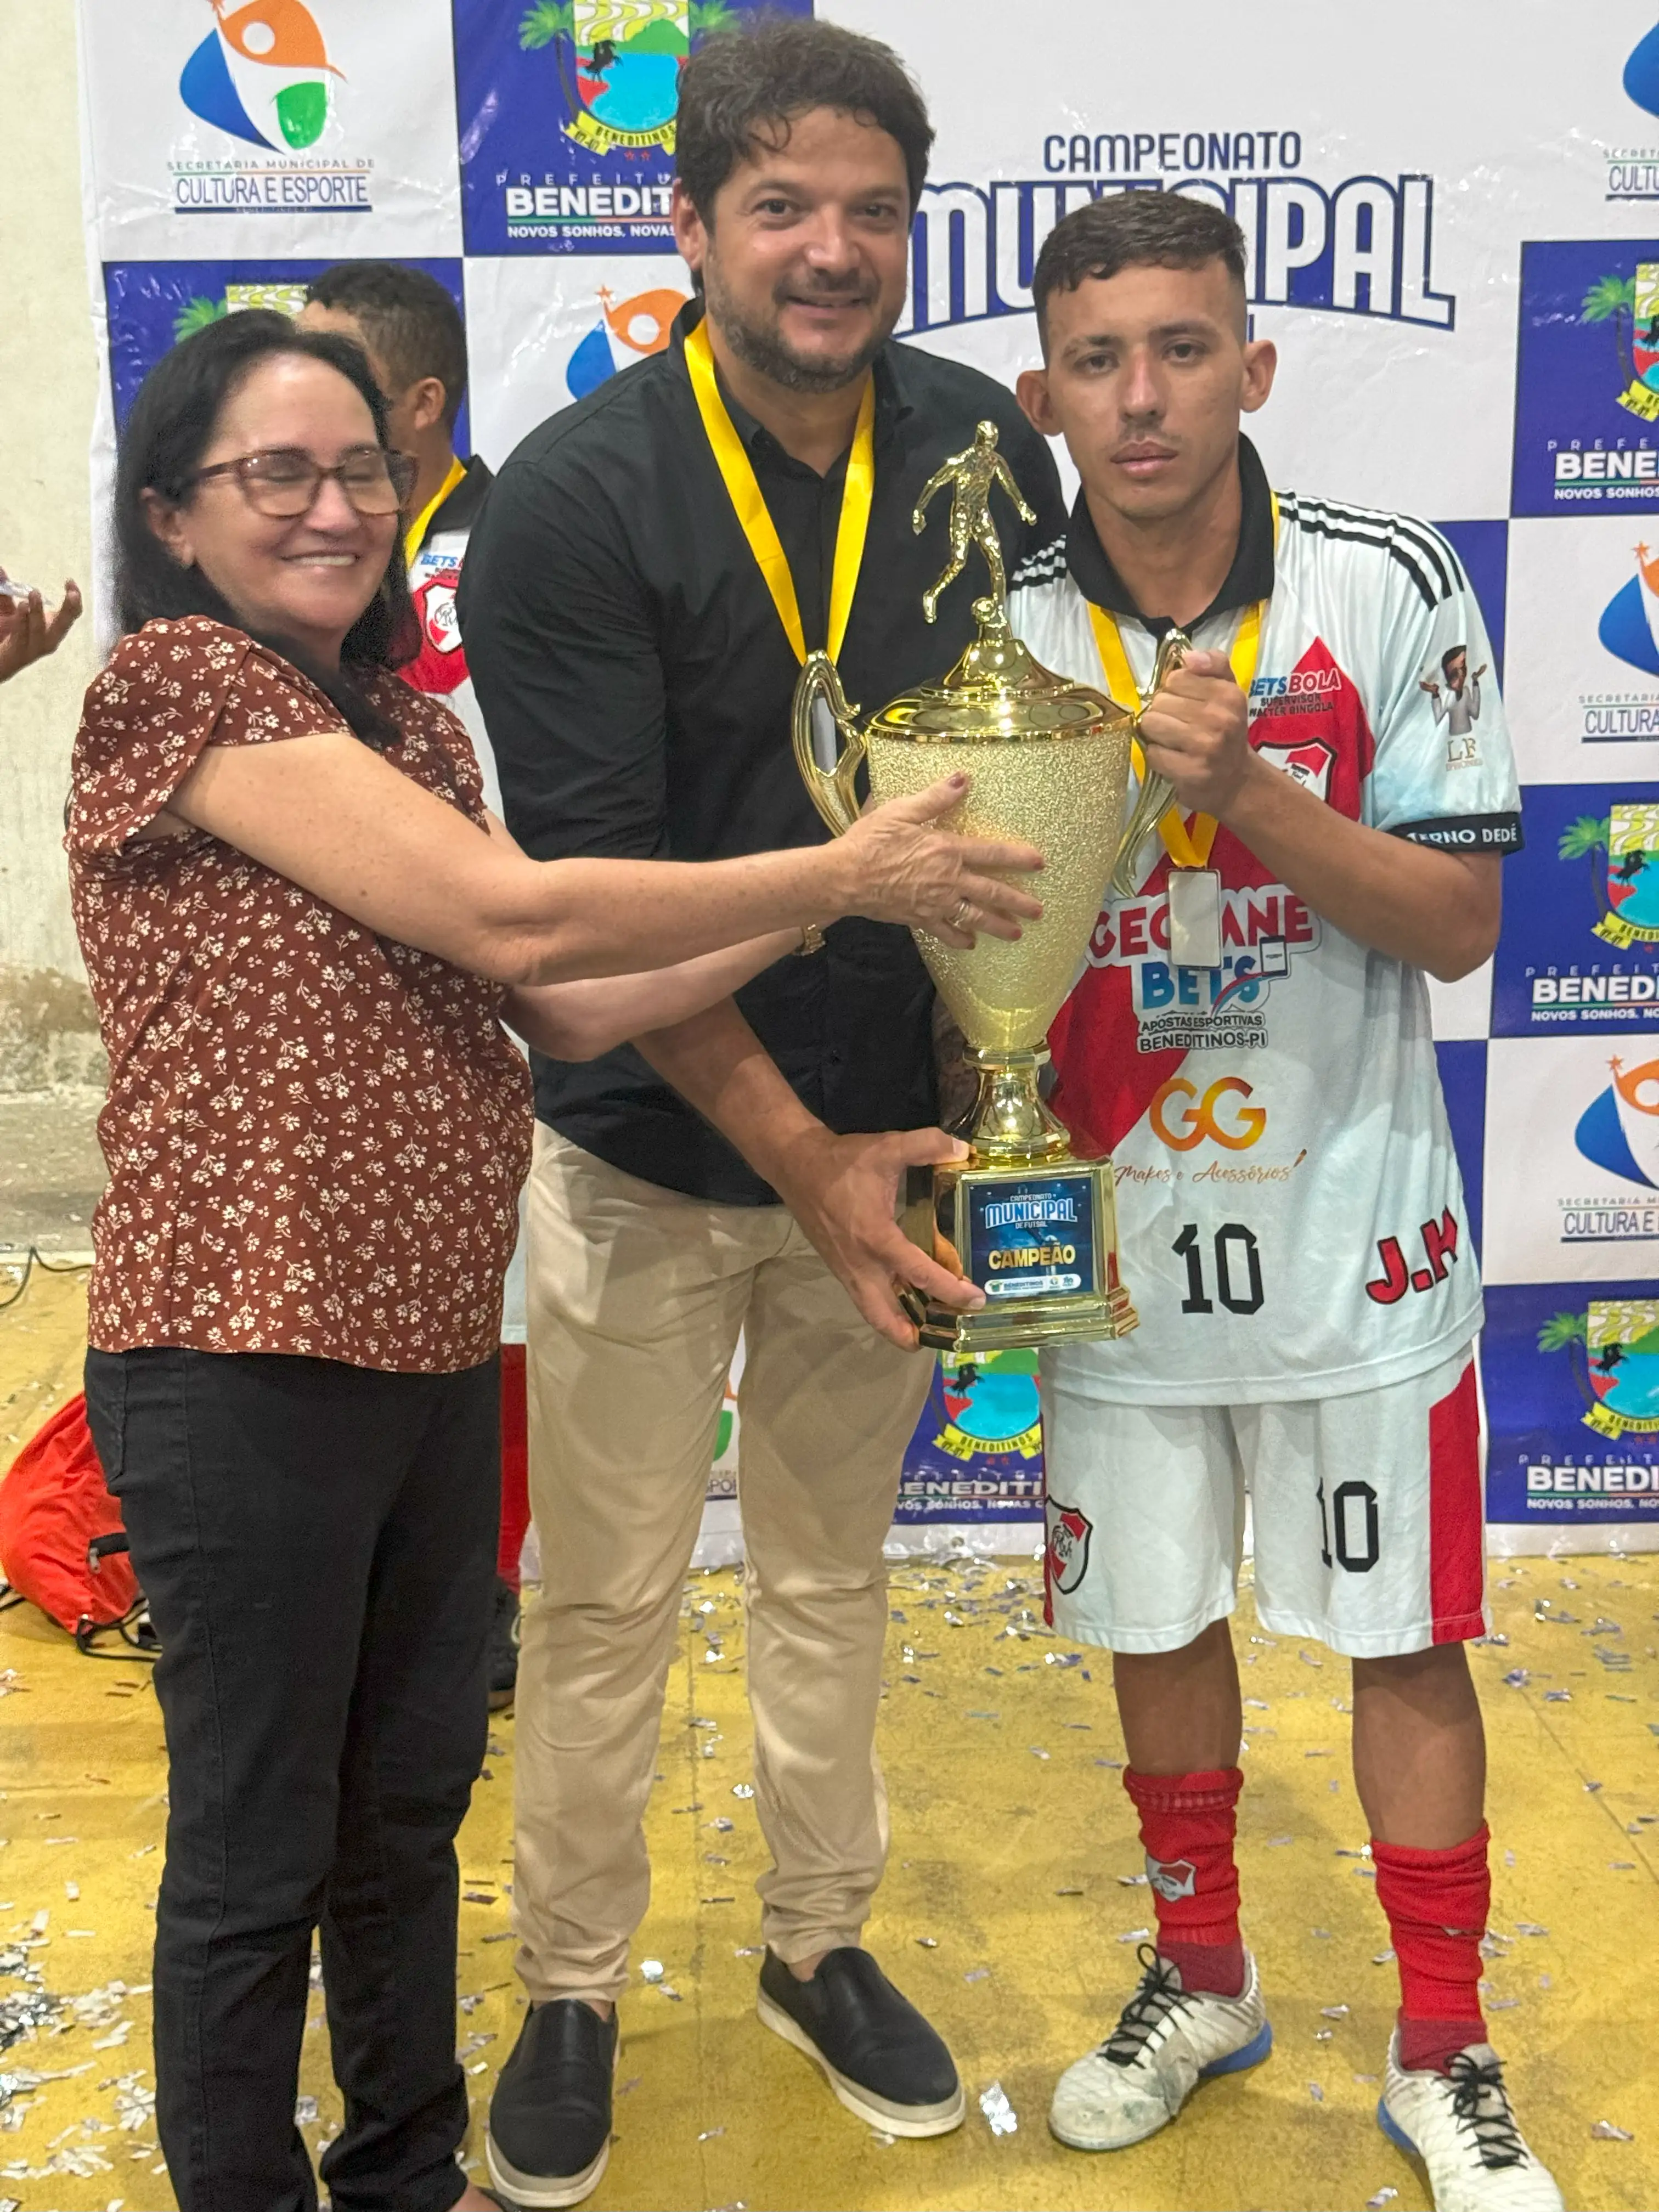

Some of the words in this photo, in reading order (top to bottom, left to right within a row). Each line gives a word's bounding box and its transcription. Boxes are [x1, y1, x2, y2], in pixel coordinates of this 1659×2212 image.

[1043, 131, 1302, 174] CAMPEONATO
[166, 160, 259, 171] SECRETARIA
[266, 159, 348, 170] MUNICIPAL
[356, 159, 374, 168] DE
[176, 177, 262, 204] CULTURA
[265, 176, 278, 203] E
[282, 176, 369, 203] ESPORTE
[495, 171, 671, 187] PREFEITU
[505, 187, 673, 217] BENEDIT
[507, 225, 558, 238] NOVOS
[562, 224, 626, 238] SONHOS,
[890, 173, 1455, 340] MUIPAL
[1547, 437, 1649, 452] PREFE
[1555, 450, 1659, 480] BENE
[1554, 488, 1602, 500] NOVOS
[1260, 693, 1322, 707] SUPERVISOR
[1482, 823, 1517, 843] DEDÉ
[1088, 894, 1313, 960] GEOANE
[1525, 962, 1659, 978] PREFEIT
[1141, 955, 1261, 1011] BETS
[1531, 1010, 1577, 1022] NOVOS
[1139, 1032, 1266, 1053] BENEDITINOS-PI
[1149, 1076, 1267, 1152] GG
[985, 1198, 1078, 1229] MUNICIPAL
[1564, 1211, 1639, 1235] CULTURA
[1642, 1211, 1655, 1232] E
[988, 1241, 1076, 1271] CAMPEÃO
[1171, 1223, 1265, 1316] 10
[1518, 1453, 1653, 1465] PREFEIT
[898, 1481, 1042, 1496] ENEDITI
[1527, 1465, 1659, 1492] BENEDI
[1526, 1498, 1573, 1510] NOVOS
